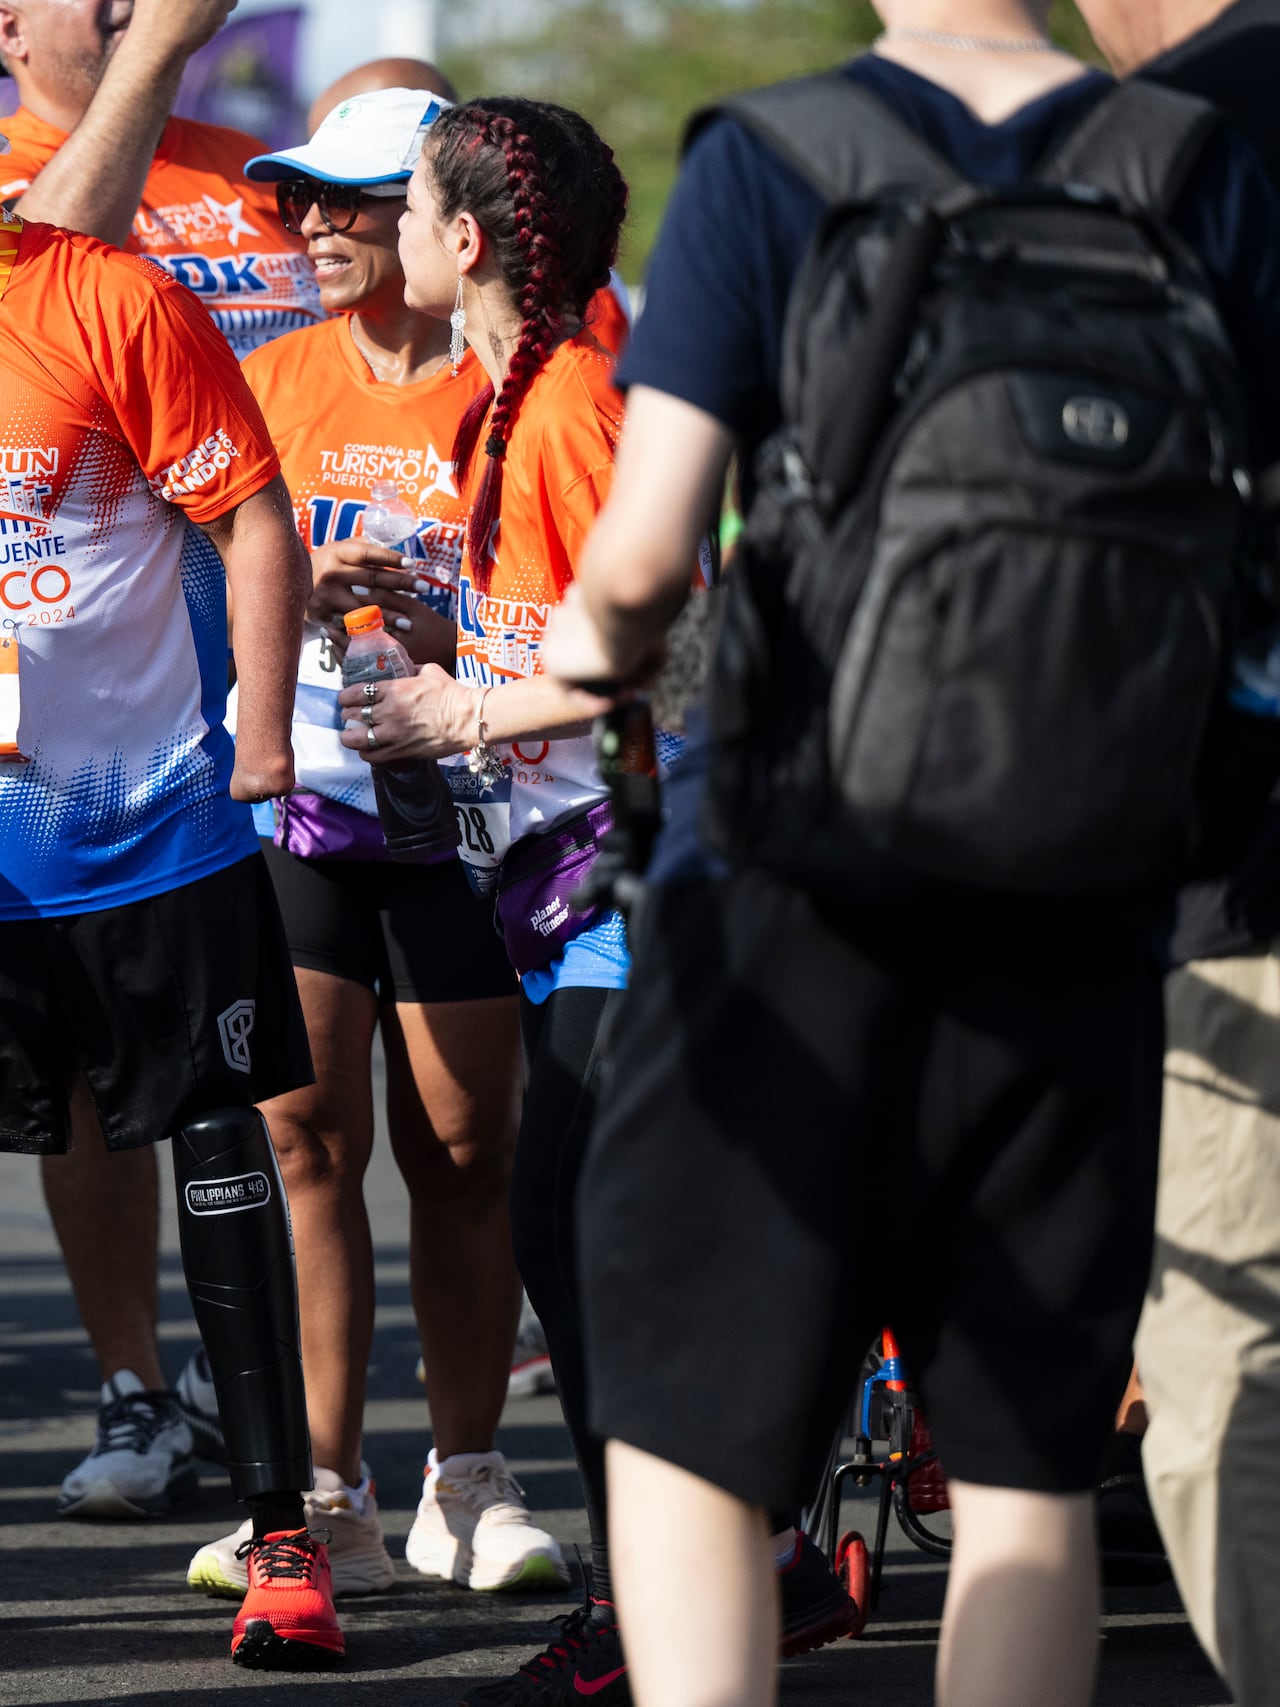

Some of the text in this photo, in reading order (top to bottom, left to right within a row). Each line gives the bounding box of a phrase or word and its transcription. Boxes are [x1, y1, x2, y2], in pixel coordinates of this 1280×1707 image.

[344, 443, 424, 460] COMPAÑÍA DE
[320, 450, 421, 481] TURISMO
[322, 471, 376, 490] PUERTO
[27, 605, 77, 627] 2024
[483, 600, 550, 629] RUN
[531, 895, 562, 931] planet
[538, 904, 569, 938] fitness
[190, 1184, 245, 1203] PHILIPPIANS
[247, 1179, 266, 1195] 4:13
